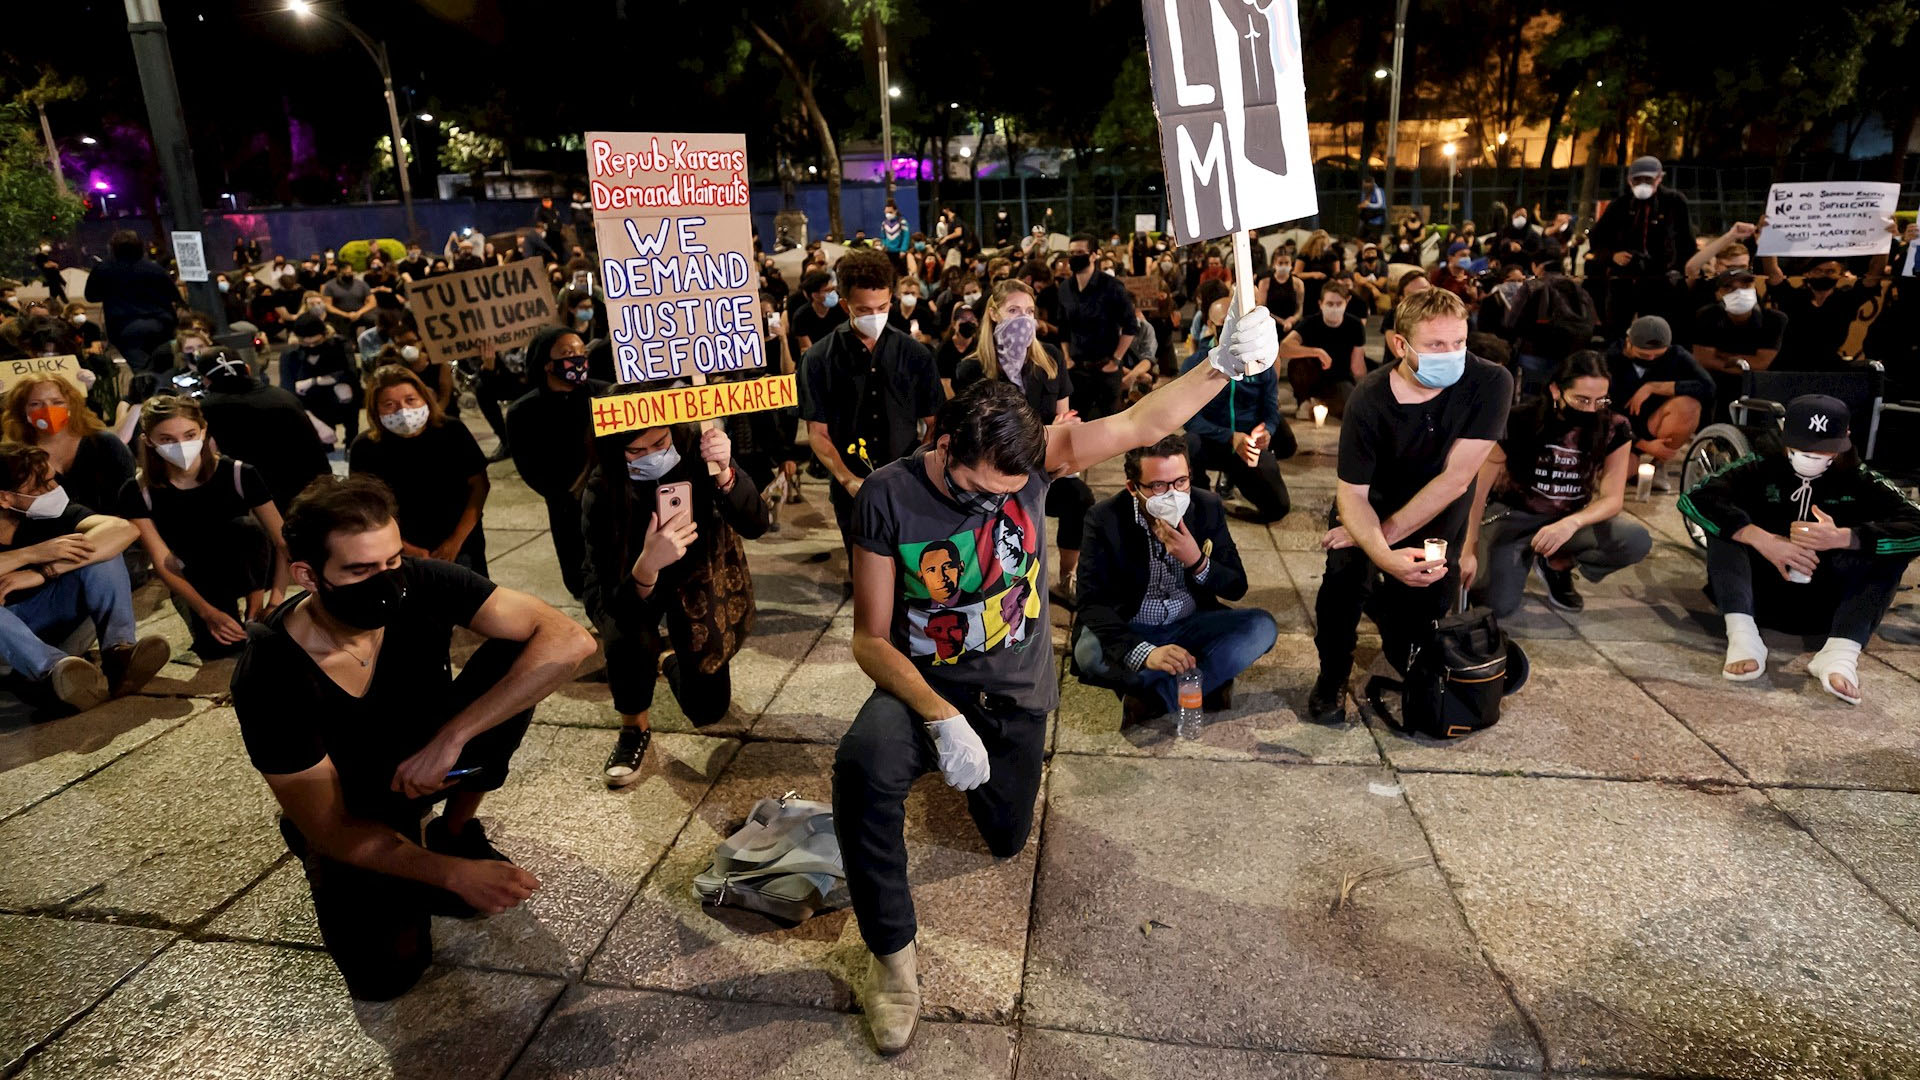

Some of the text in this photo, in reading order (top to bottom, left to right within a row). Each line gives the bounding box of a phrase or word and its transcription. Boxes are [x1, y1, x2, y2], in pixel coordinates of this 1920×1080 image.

[592, 137, 745, 178] Repub-Karens
[591, 174, 749, 210] Demand Haircuts
[1176, 121, 1234, 239] M
[1775, 202, 1793, 216] NO
[624, 217, 708, 256] WE
[411, 267, 538, 310] TU LUCHA
[603, 251, 749, 299] DEMAND
[425, 297, 550, 341] ES MI LUCHA
[613, 296, 755, 343] JUSTICE
[12, 358, 68, 375] BLACK
[618, 332, 762, 383] REFORM
[593, 378, 793, 431] #DONTBEAKAREN
[1808, 413, 1829, 432] NY
[1535, 468, 1548, 476] no
[1537, 482, 1551, 491] no
